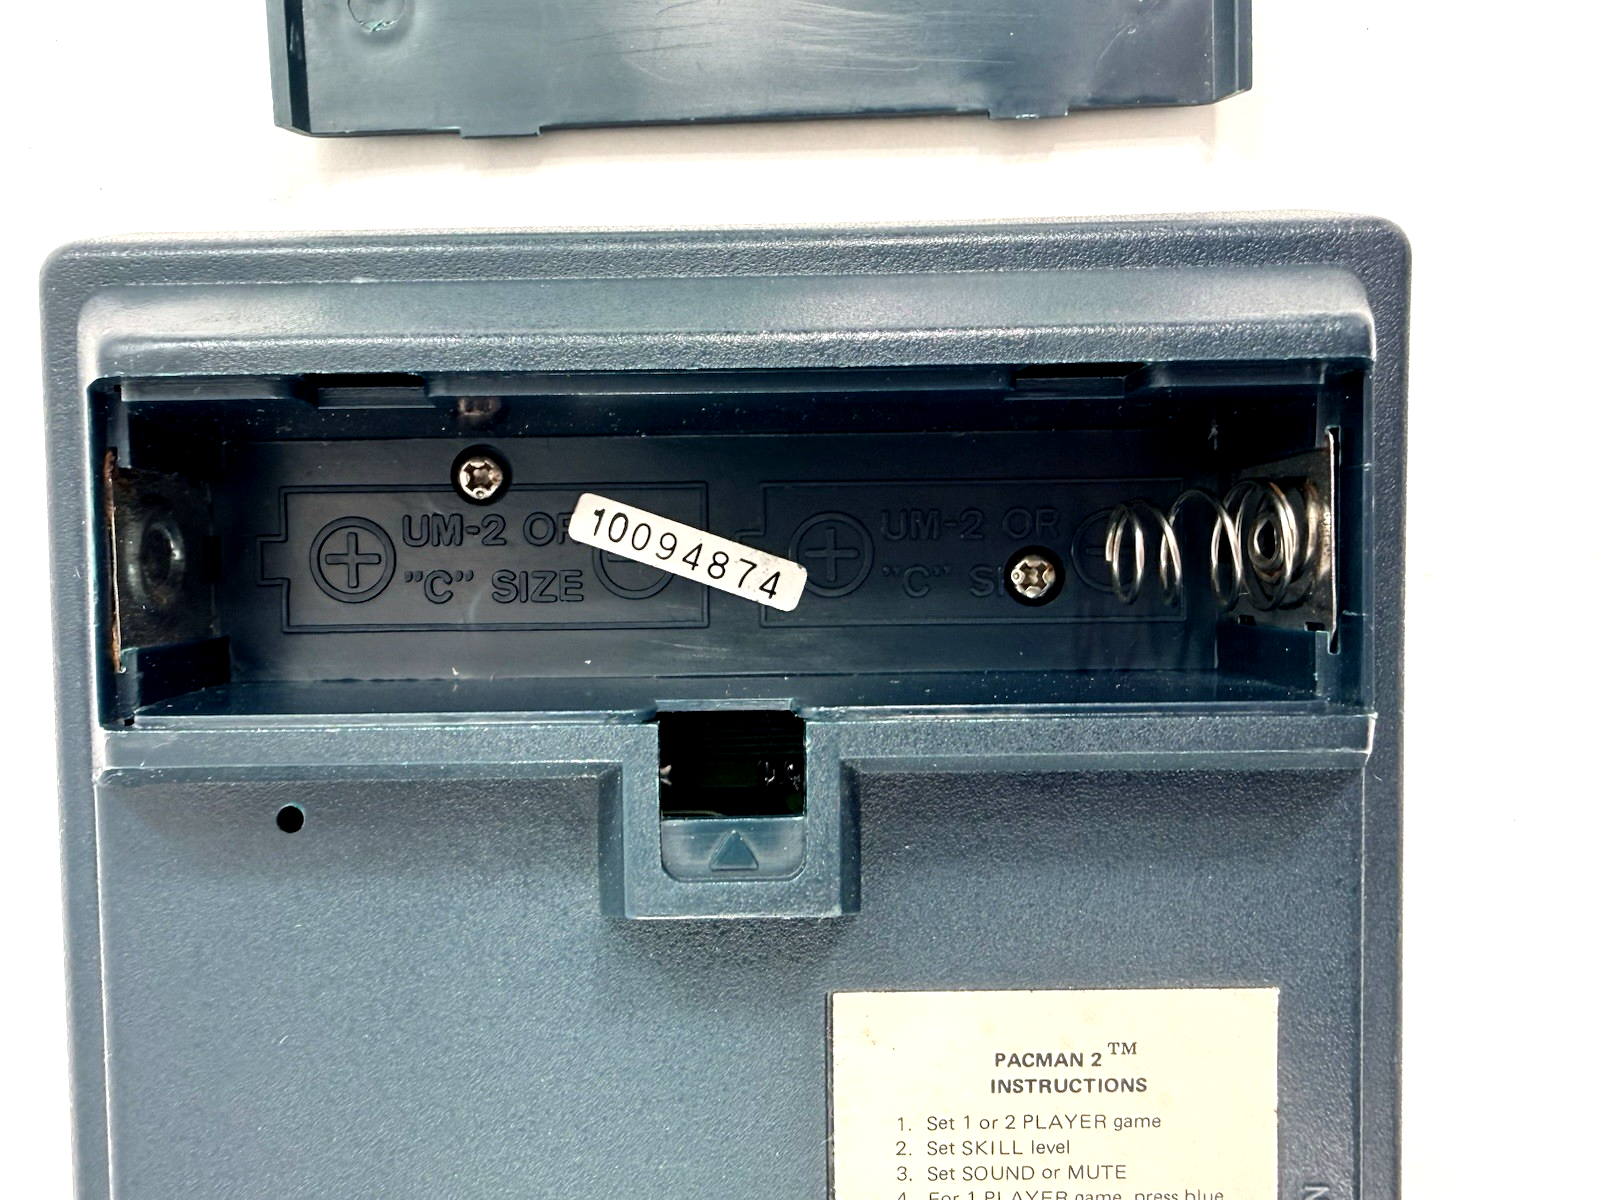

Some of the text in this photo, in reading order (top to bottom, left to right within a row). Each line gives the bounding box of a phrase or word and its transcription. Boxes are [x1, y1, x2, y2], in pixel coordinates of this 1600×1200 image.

[402, 512, 508, 548] UM-2
[880, 505, 1061, 541] UM-2 OR
[593, 508, 781, 599] 10094874
[491, 569, 585, 605] SIZE
[995, 1041, 1137, 1068] PACMAN 2 TM
[990, 1077, 1148, 1094] INSTRUCTIONS
[897, 1114, 1162, 1133] 1. Set 1 or 2 PLAYER game
[895, 1139, 1070, 1156] 2. Set SKILL level
[896, 1164, 1127, 1181] 3. Set SOUND or MUTE
[929, 1191, 960, 1200] For
[984, 1190, 1068, 1200] PLAYER
